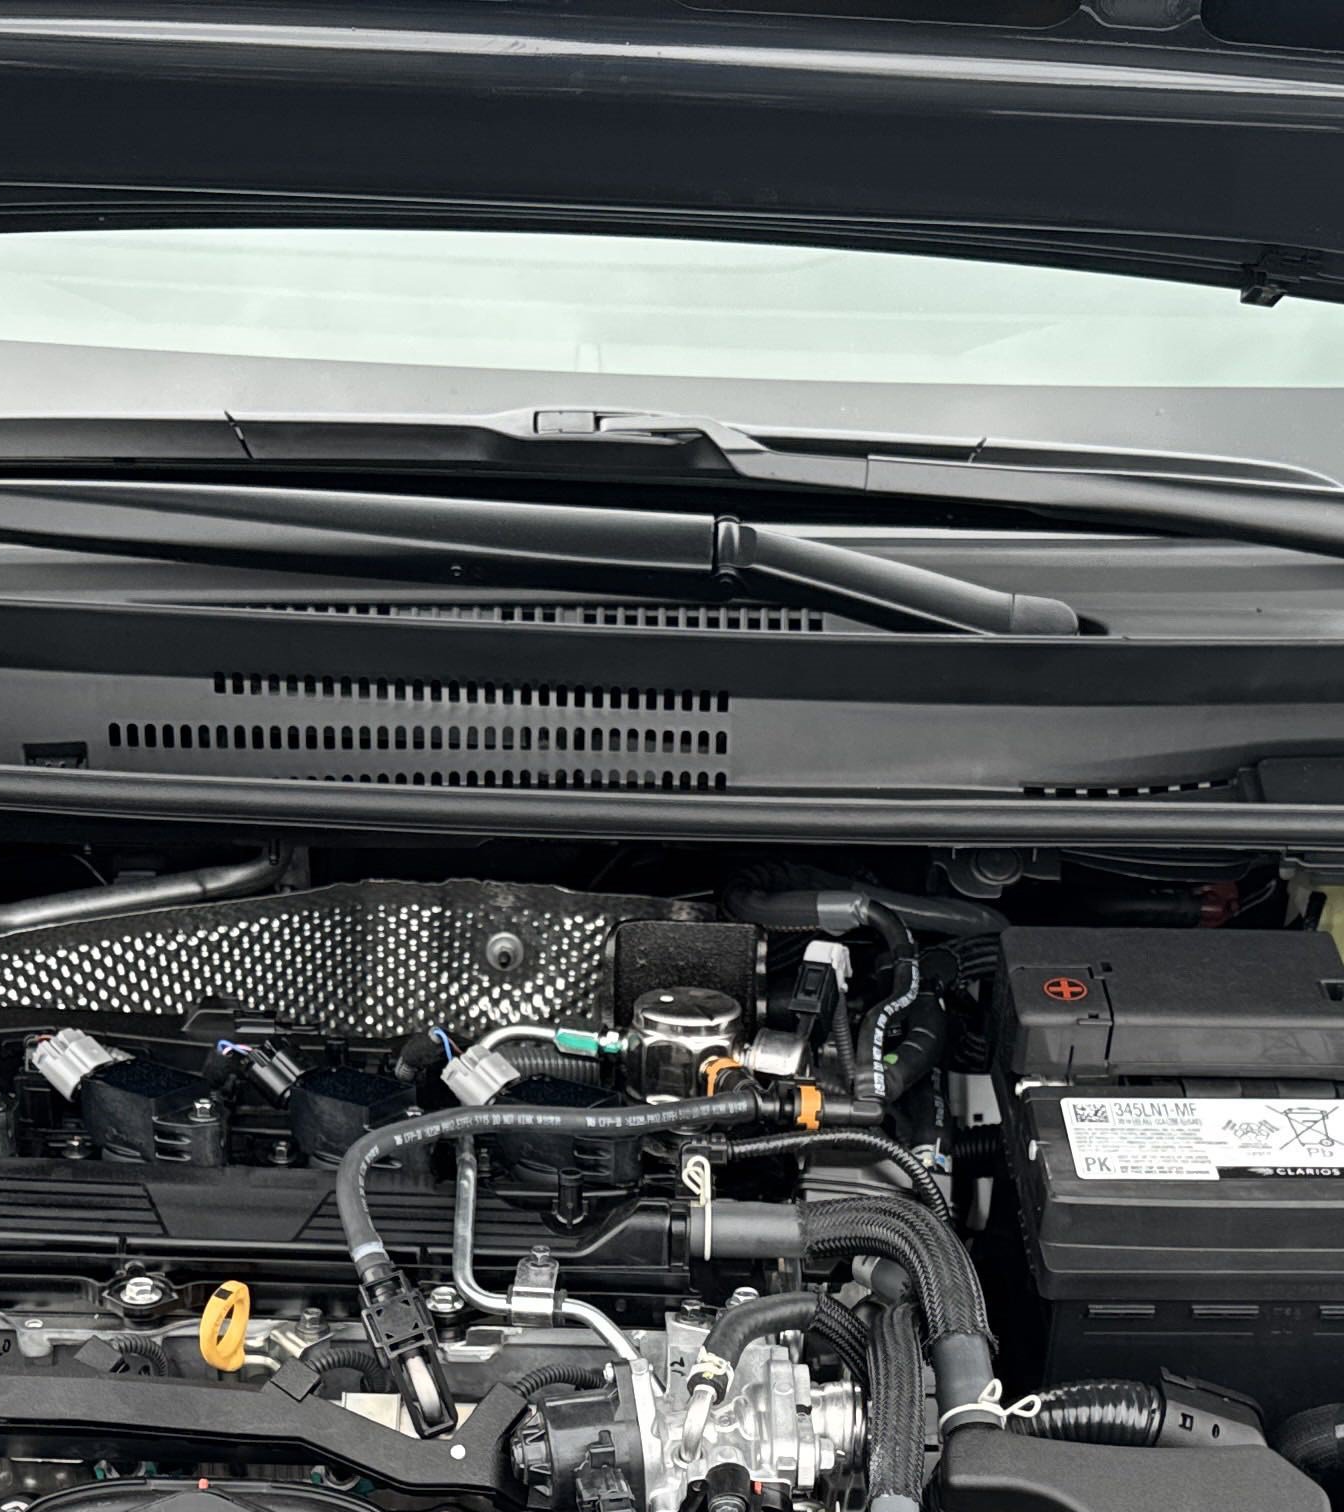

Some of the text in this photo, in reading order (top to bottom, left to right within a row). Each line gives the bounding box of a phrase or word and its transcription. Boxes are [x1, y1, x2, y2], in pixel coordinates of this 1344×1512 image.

[1113, 1102, 1197, 1117] 345LN1-MF
[1084, 1156, 1112, 1173] PK
[1276, 1167, 1341, 1176] CLARIOS
